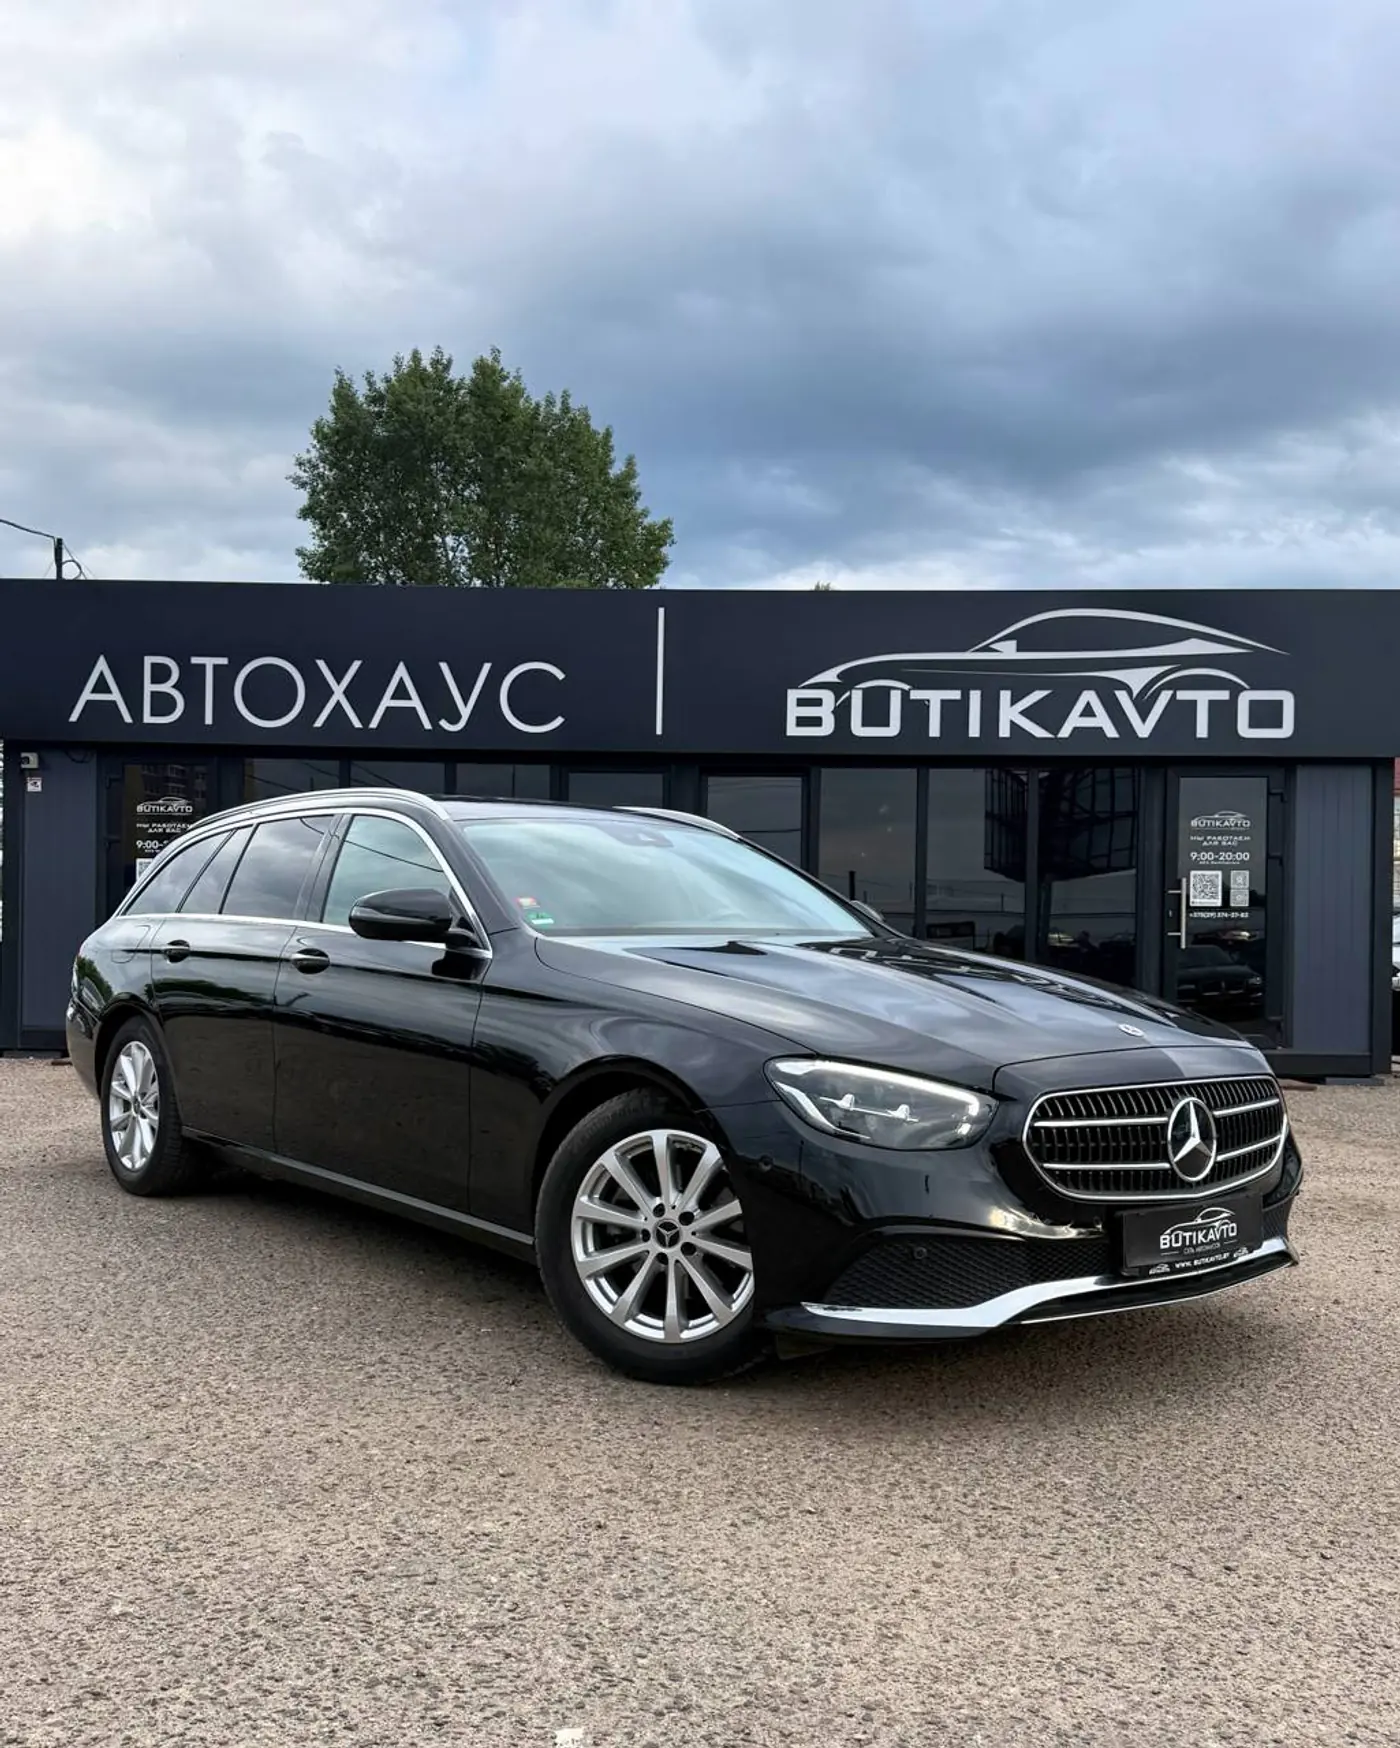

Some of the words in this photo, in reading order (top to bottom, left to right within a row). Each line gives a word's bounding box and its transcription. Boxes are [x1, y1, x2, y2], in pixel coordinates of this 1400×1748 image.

[69, 654, 567, 733] АВТОХАУС
[786, 688, 1295, 739] BUTIKAVTO
[136, 805, 193, 813] BUTIKAVTO
[1190, 819, 1251, 828] BUTIKAVTO
[1190, 851, 1250, 861] 9:00-20:00
[1160, 1222, 1238, 1250] BUTIKAVTO
